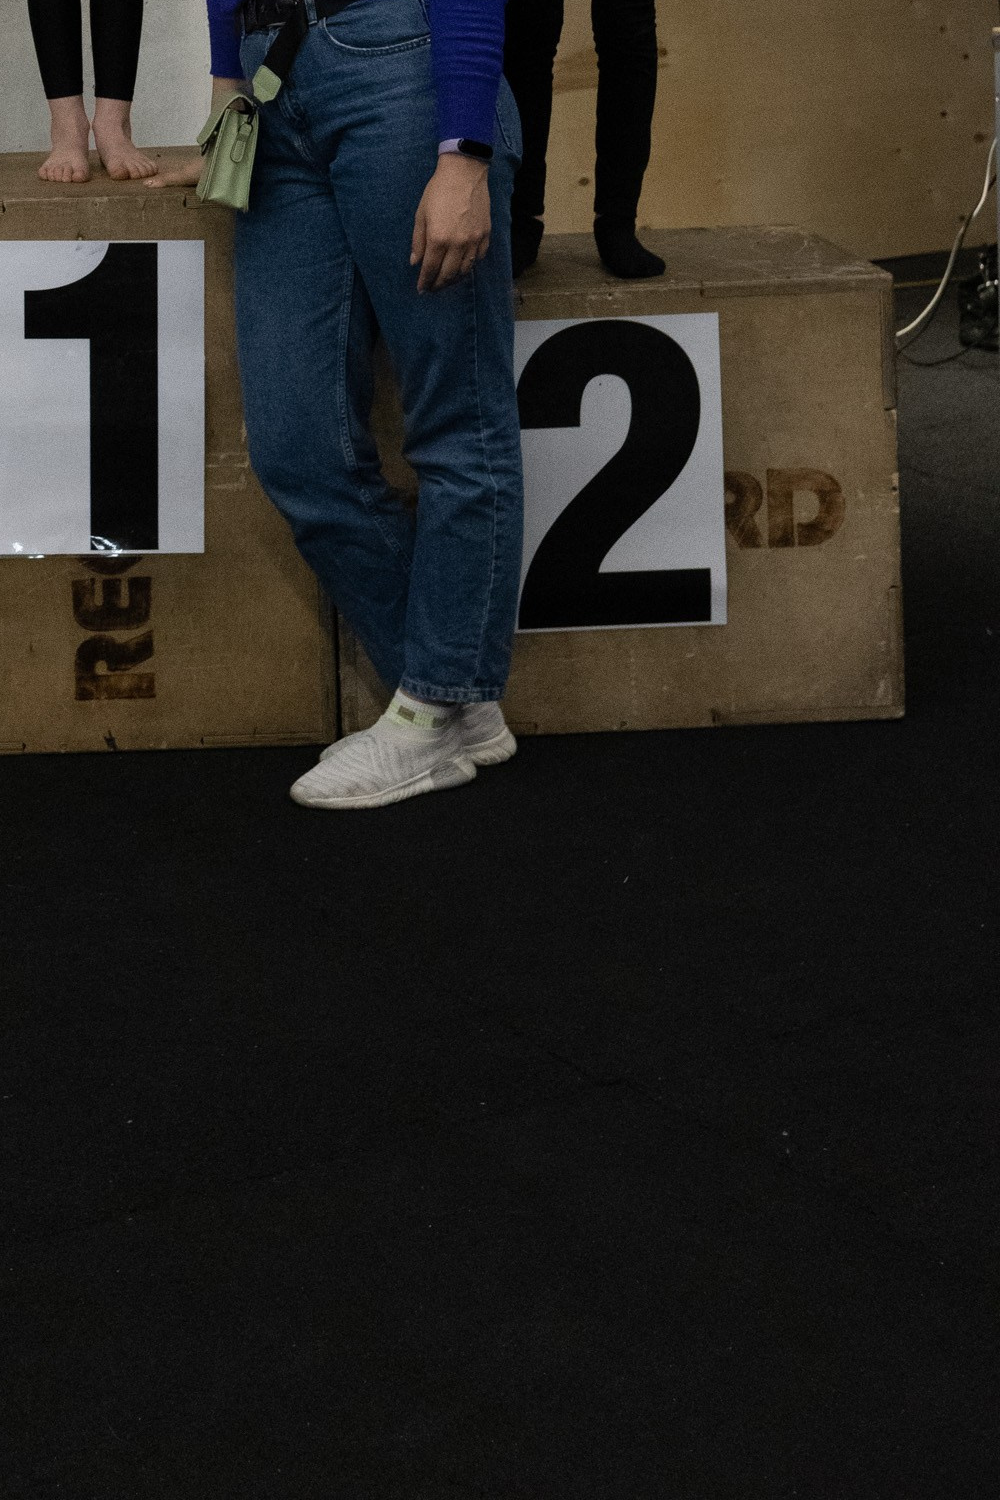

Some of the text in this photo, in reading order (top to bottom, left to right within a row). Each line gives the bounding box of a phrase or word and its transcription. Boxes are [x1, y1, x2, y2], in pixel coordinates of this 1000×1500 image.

[23, 242, 158, 550] 1
[518, 319, 711, 629] 2
[71, 556, 156, 701] RE
